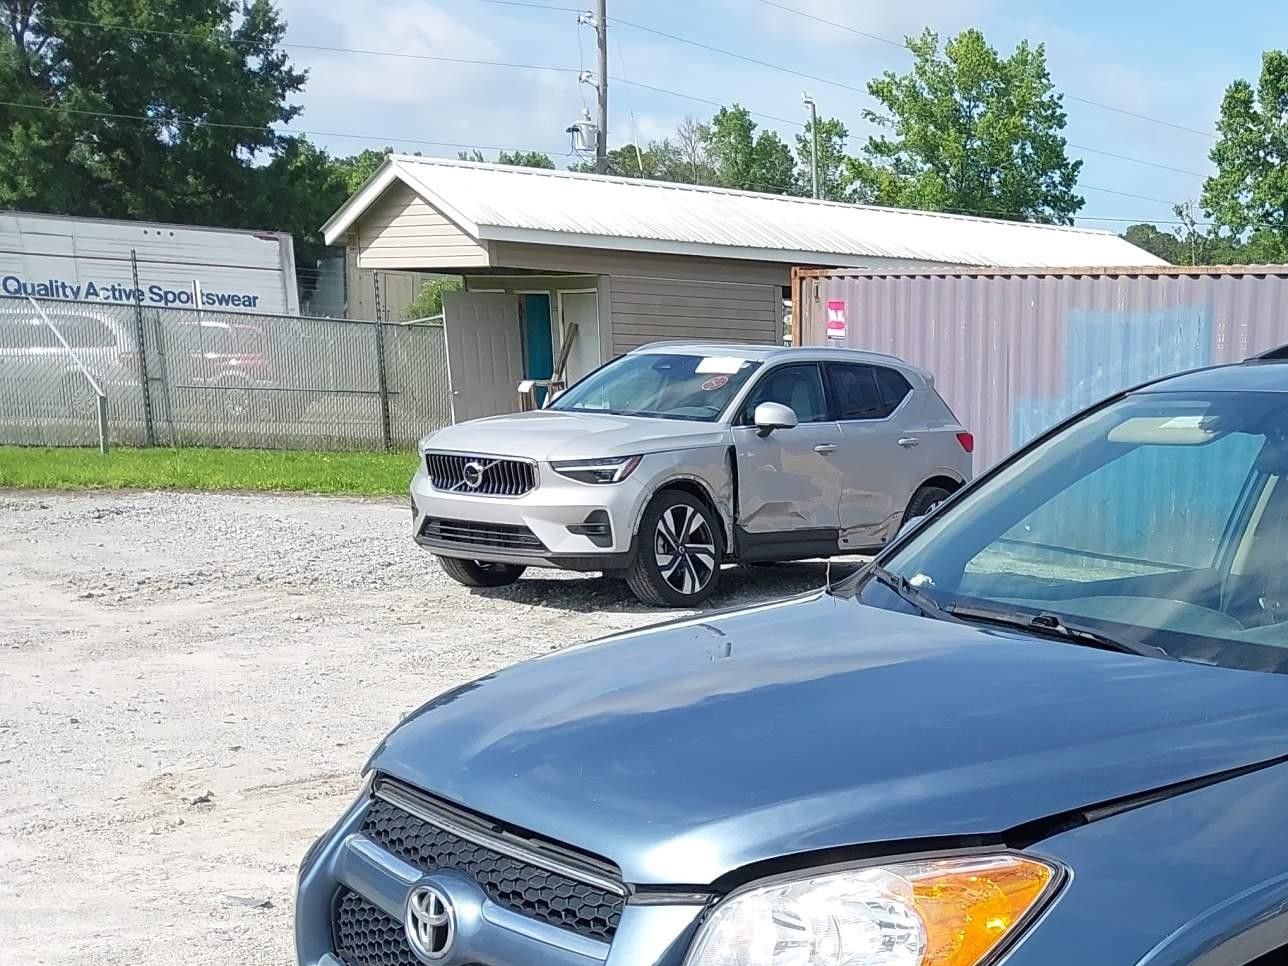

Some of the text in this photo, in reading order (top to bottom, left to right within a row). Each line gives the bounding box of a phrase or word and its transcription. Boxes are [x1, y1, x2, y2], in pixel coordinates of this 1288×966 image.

[2, 276, 259, 308] Quality Active Sportswear
